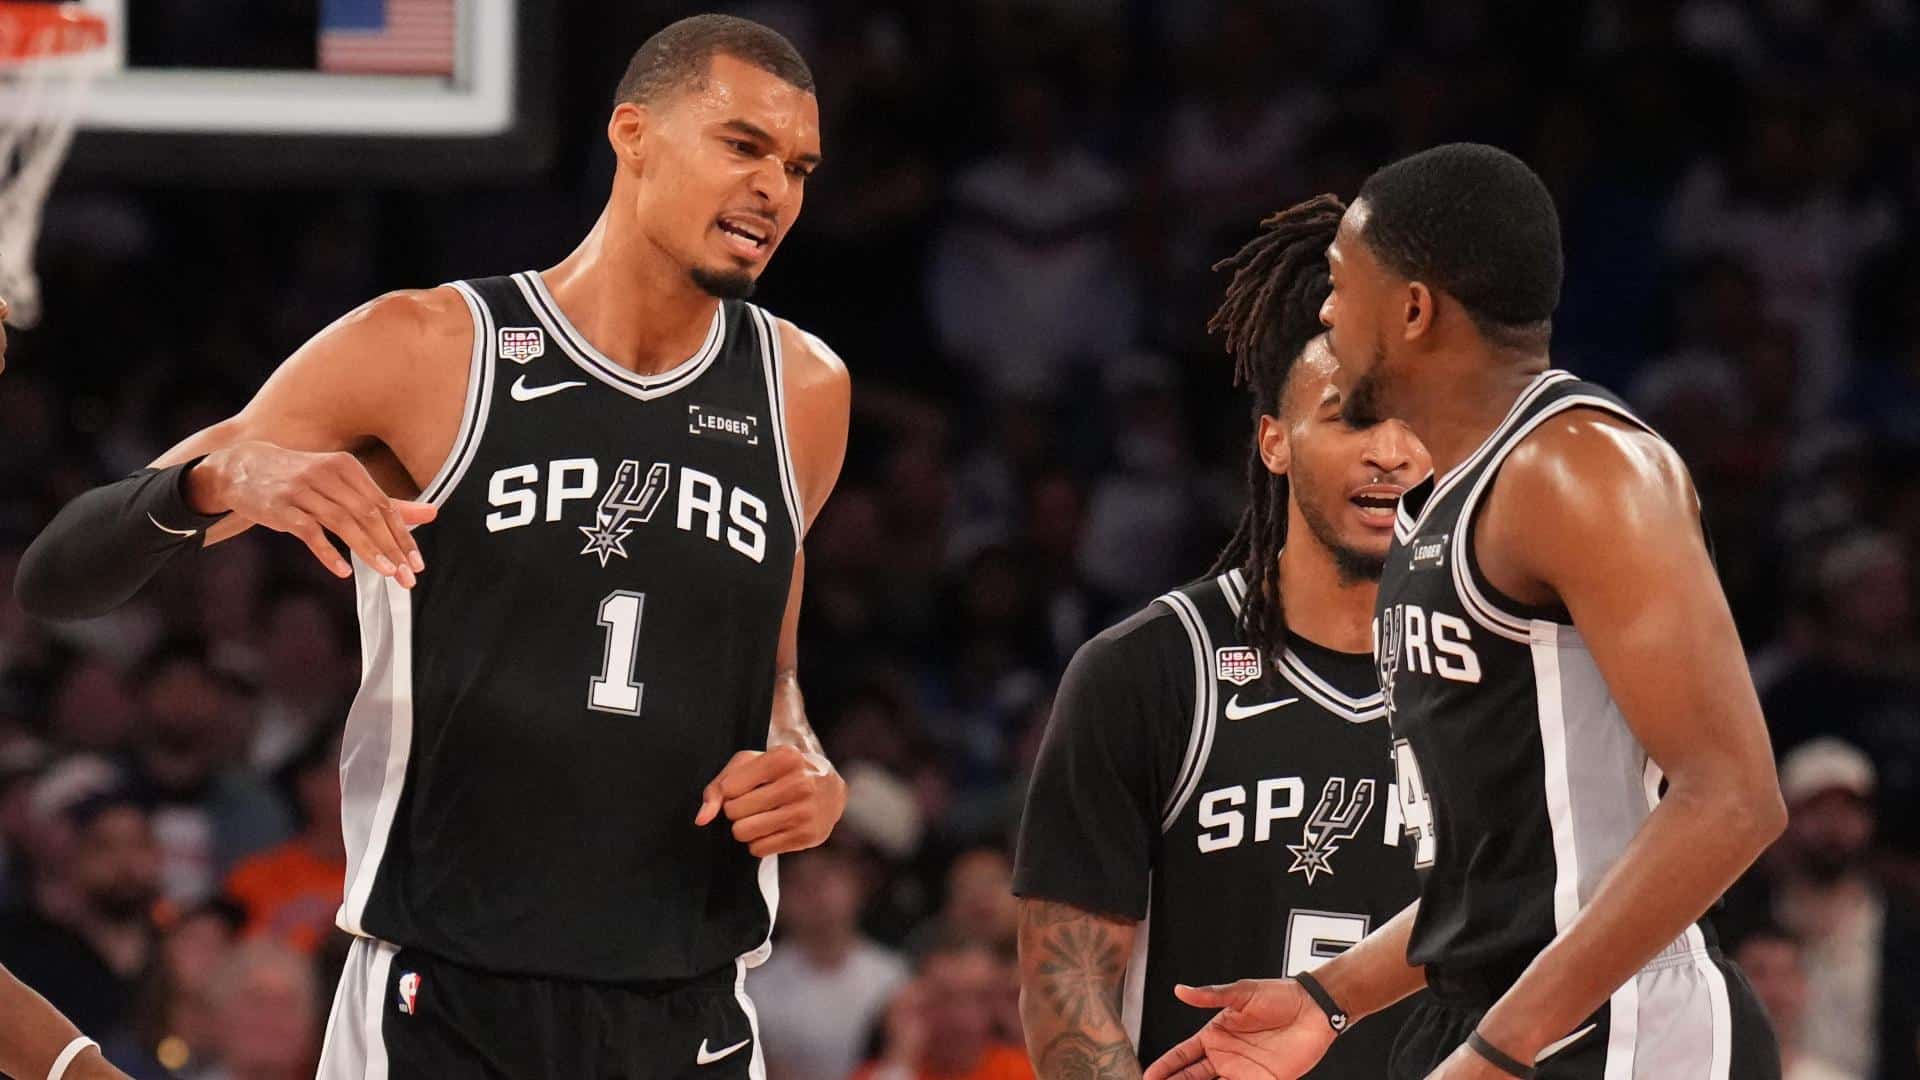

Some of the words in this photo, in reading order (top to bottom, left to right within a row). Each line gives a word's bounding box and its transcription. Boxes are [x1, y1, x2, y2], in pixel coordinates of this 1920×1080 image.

[503, 332, 538, 341] USA
[503, 345, 540, 356] 250
[697, 413, 750, 436] LEDGER
[485, 457, 768, 567] SPURS
[586, 589, 646, 717] 1
[1221, 651, 1256, 661] USA
[1221, 666, 1258, 677] 250
[1393, 737, 1437, 870] 4
